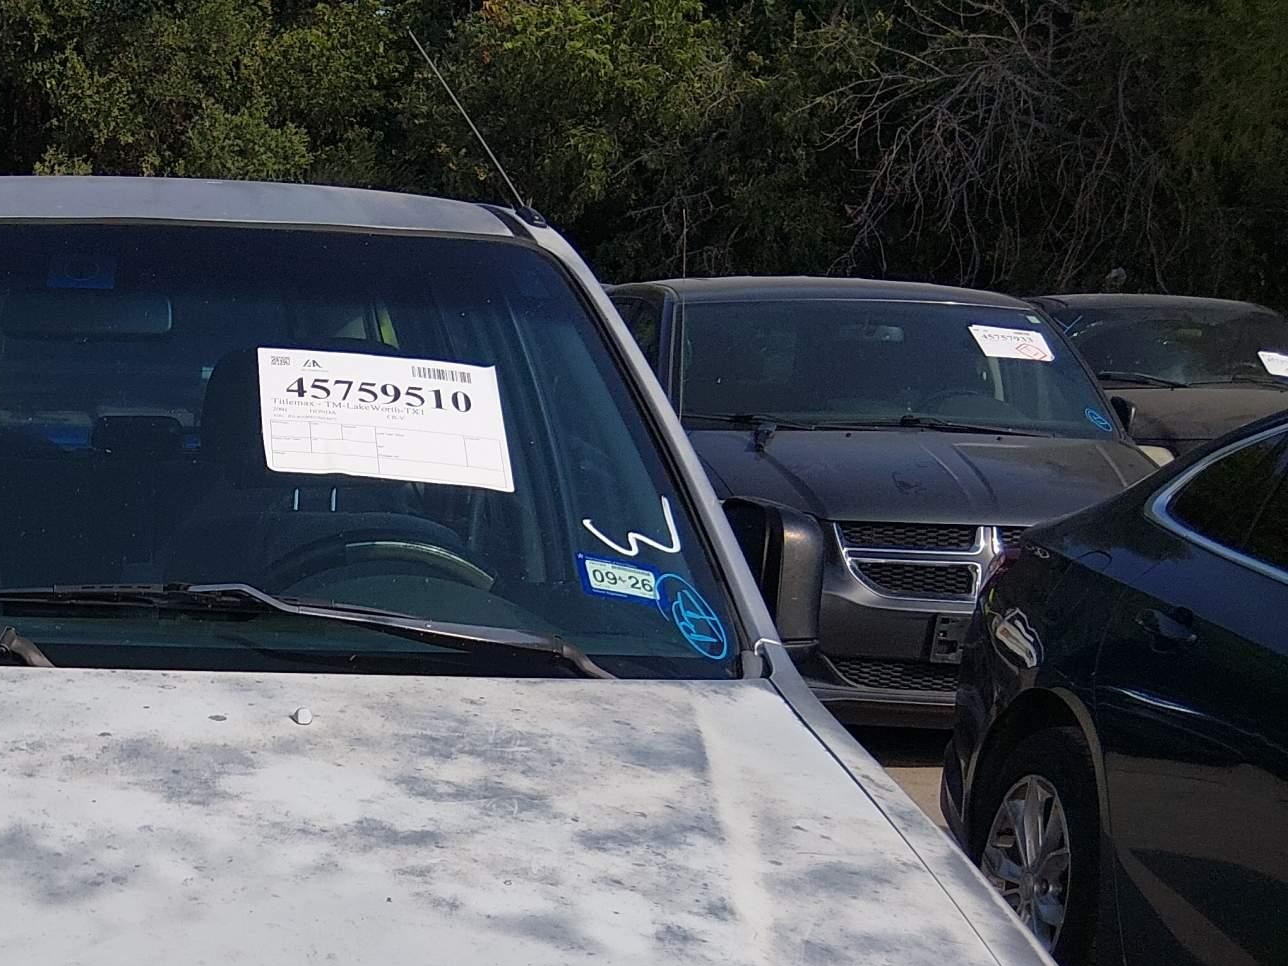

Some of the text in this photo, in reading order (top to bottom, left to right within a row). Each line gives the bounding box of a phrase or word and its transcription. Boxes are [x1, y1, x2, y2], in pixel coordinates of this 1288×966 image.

[273, 397, 315, 407] Titlemax
[286, 377, 472, 413] 45759510
[592, 569, 653, 592] 09 26
